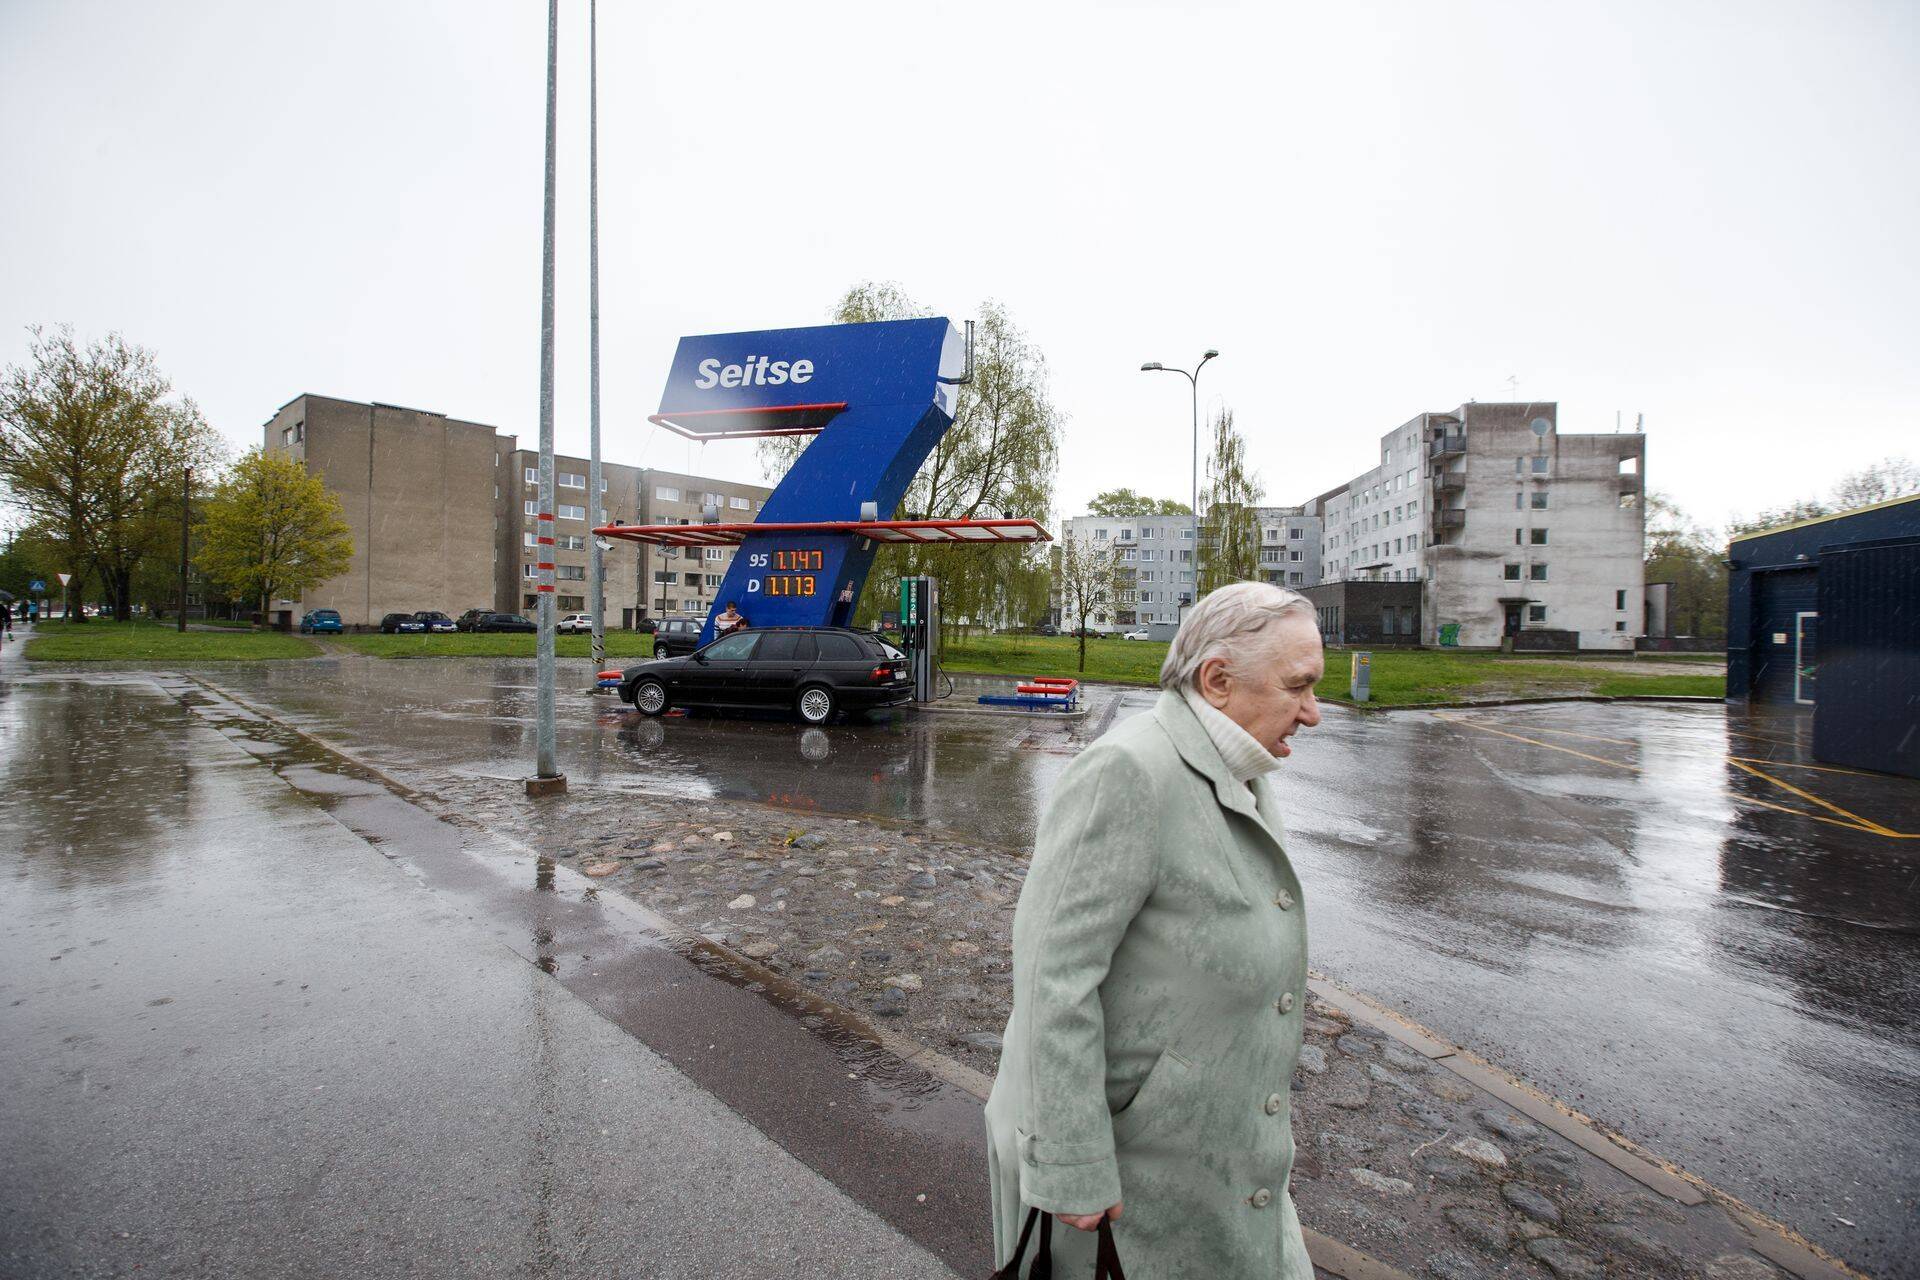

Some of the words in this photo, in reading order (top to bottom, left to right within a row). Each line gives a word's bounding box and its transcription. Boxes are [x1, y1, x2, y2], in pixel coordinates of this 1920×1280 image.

[694, 355, 814, 390] Seitse
[749, 553, 769, 567] 95
[777, 551, 822, 570] 1.147
[747, 579, 760, 593] D
[770, 576, 814, 595] 1.113
